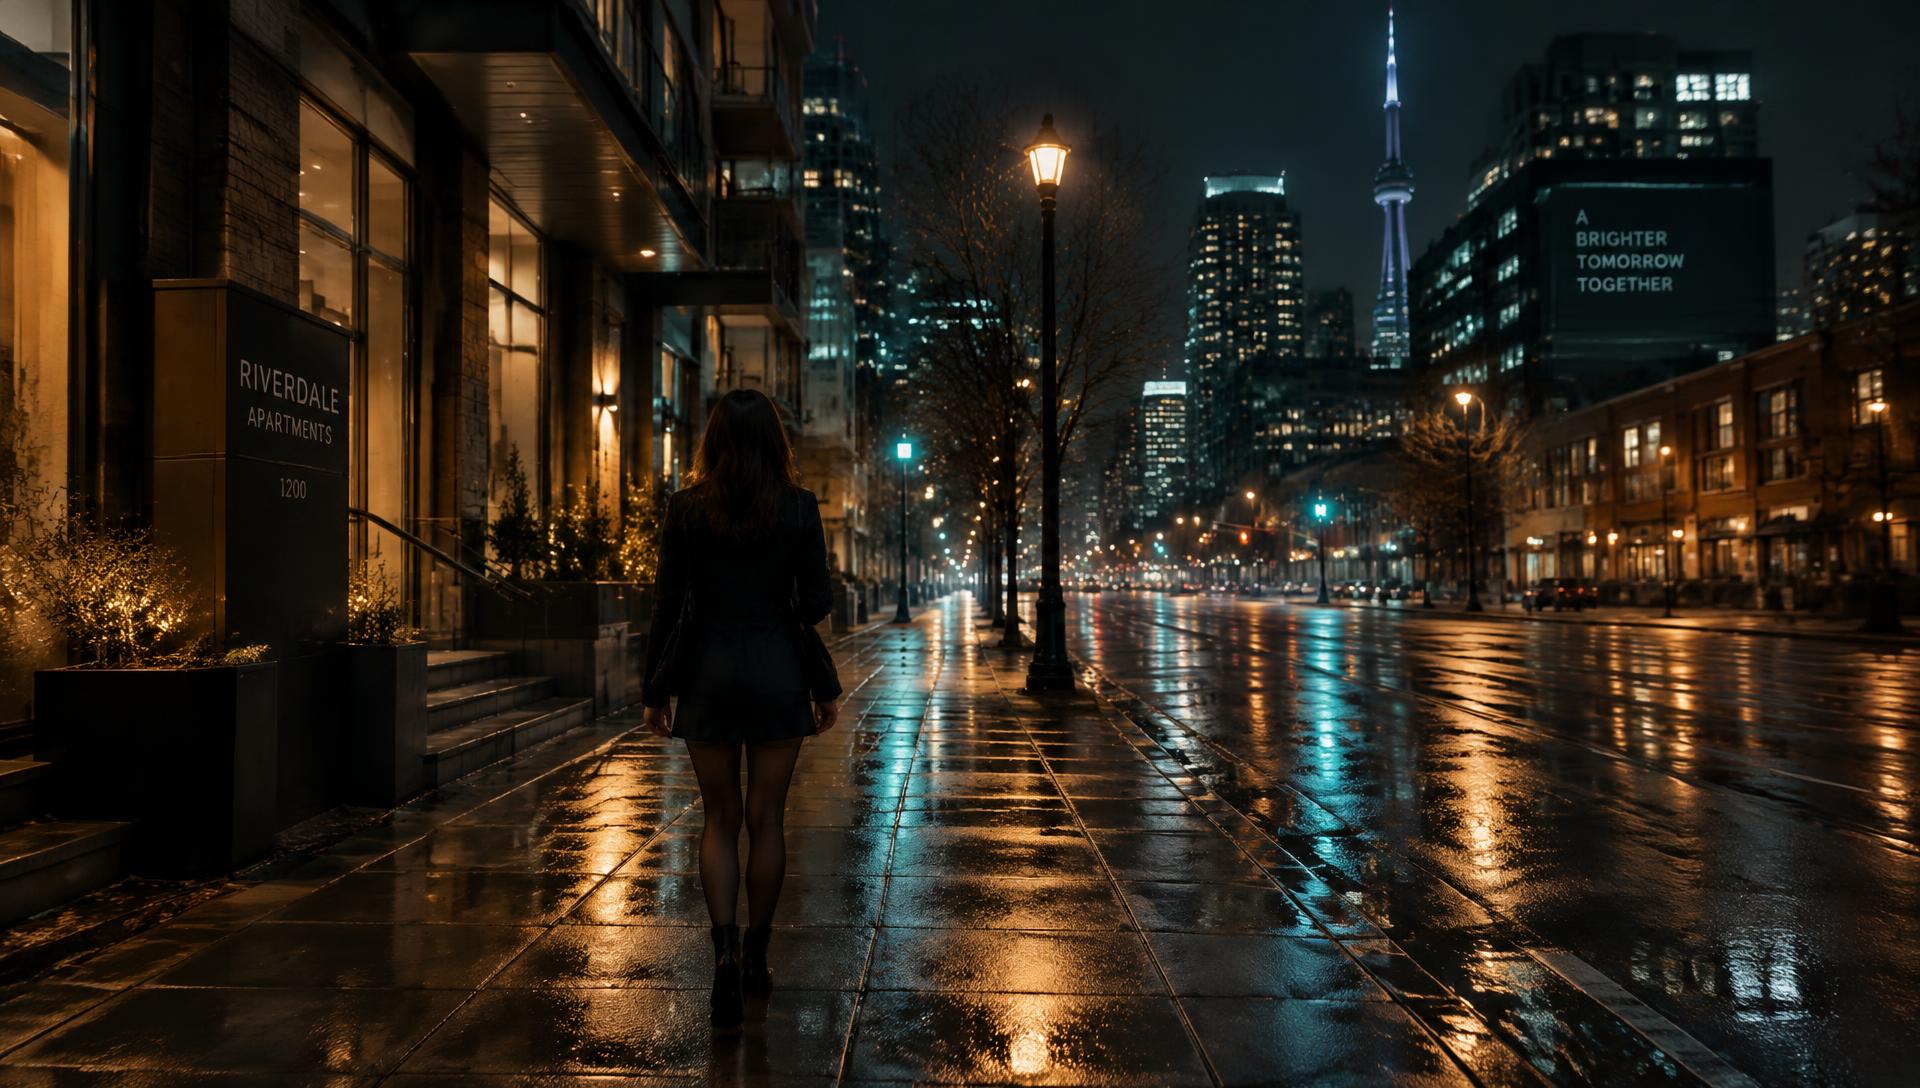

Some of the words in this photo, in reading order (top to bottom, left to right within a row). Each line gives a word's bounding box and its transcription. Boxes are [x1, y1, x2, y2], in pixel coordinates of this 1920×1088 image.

[1576, 208, 1589, 226] A
[1576, 230, 1668, 247] BRIGHTER
[1576, 253, 1685, 270] TOMORROW
[1577, 276, 1673, 292] TOGETHER
[240, 359, 340, 415] RIVERDALE
[248, 406, 332, 445] APARTMENTS
[280, 477, 307, 499] 1200
